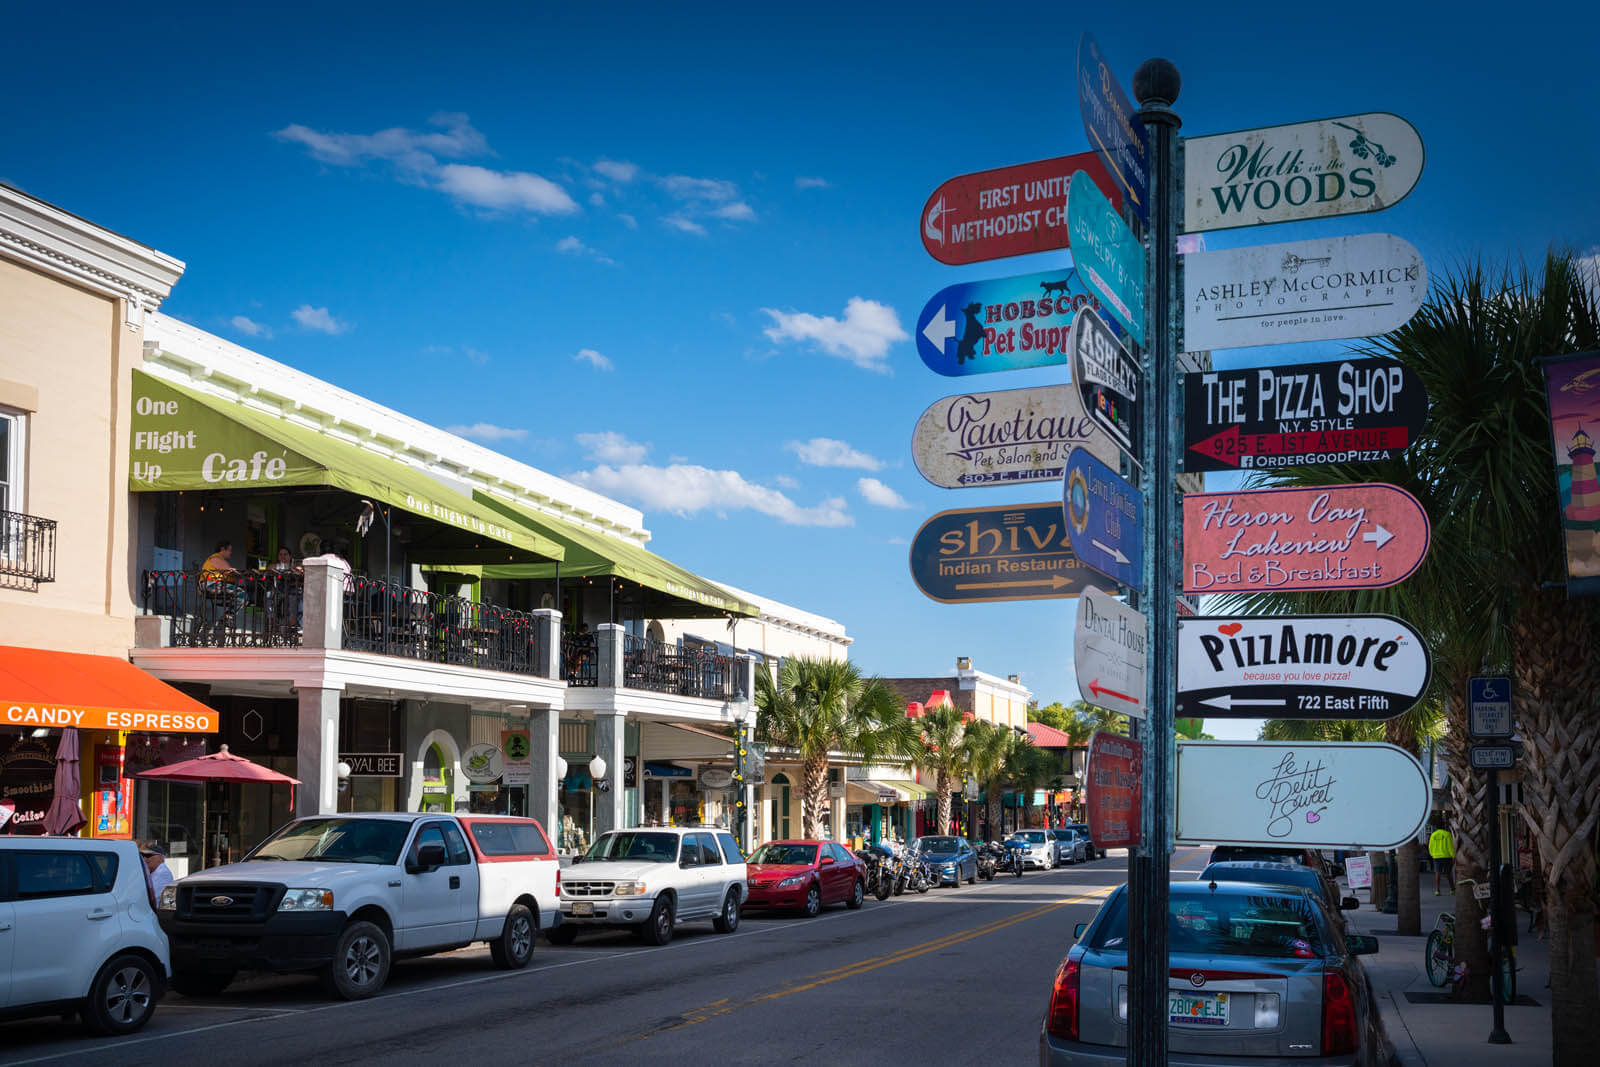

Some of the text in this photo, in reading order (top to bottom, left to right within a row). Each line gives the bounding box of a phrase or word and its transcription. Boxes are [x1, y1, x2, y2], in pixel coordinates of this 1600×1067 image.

[1216, 140, 1346, 183] Walk in the
[979, 176, 1072, 210] FIRST UNITE
[1211, 167, 1376, 215] WOODS
[951, 209, 1042, 244] METHODIST
[1075, 215, 1116, 269] JEWELRY
[1195, 267, 1418, 302] ASHLEY McCORMICK
[1261, 319, 1274, 328] for
[1277, 317, 1308, 328] people
[1311, 316, 1321, 324] in
[983, 325, 1015, 356] Pet
[1080, 314, 1136, 398] ASHLEY'S
[136, 396, 178, 416] One
[1202, 362, 1403, 424] THE PIZZA SHOP
[1279, 418, 1354, 433] N.Y. STYLE
[135, 431, 197, 454] Flight
[974, 451, 994, 467] Pet
[997, 445, 1028, 465] Salon
[1035, 443, 1058, 461] and
[1214, 437, 1248, 456] 925
[1256, 436, 1272, 454] E.
[1317, 431, 1389, 450] AVENUE
[133, 449, 287, 483] Up Café
[964, 474, 995, 484] 805
[407, 495, 430, 513] One
[433, 504, 468, 528] Flight
[471, 516, 486, 534] Up
[1202, 493, 1368, 540] Heron Cay
[1219, 528, 1353, 560] Lakeview
[938, 557, 1087, 577] Indian Restauran
[1191, 563, 1241, 589] Bed
[1265, 557, 1382, 586] Breakfast
[1243, 671, 1352, 683] because you love pizza!
[7, 706, 209, 730] CANDY ESPRESSO
[1297, 695, 1389, 710] 722 East Fifth
[378, 758, 396, 772] BEE
